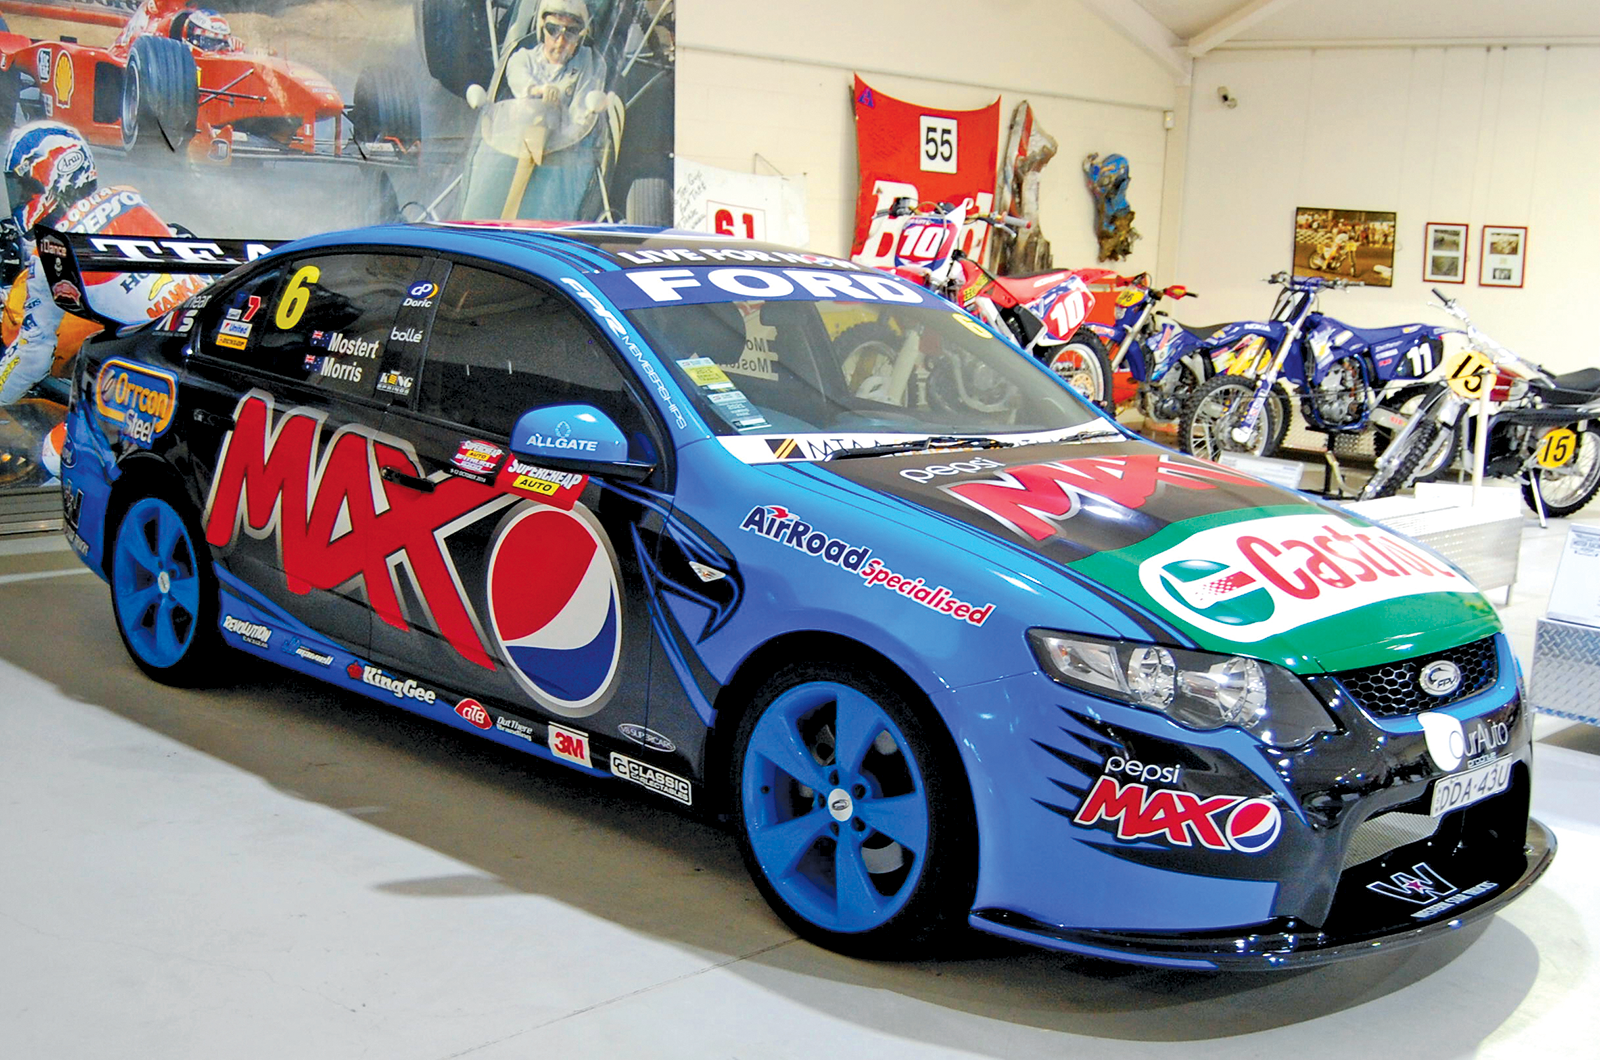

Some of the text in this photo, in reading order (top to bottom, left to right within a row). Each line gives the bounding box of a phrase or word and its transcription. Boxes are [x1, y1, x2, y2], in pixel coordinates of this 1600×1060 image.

[925, 127, 953, 162] 55
[62, 154, 81, 169] Arai
[617, 249, 707, 264] LIVE
[699, 249, 781, 263] FOR
[899, 225, 949, 258] 10
[276, 265, 320, 329] 6
[626, 268, 924, 304] FORD
[402, 298, 433, 308] Doric
[1050, 290, 1085, 338] 10
[328, 332, 380, 359] Mostert
[391, 327, 423, 343] bollé
[320, 356, 363, 382] Morris
[1406, 342, 1432, 377] 11
[1451, 355, 1485, 393] 15
[115, 372, 170, 420] Orrcon
[621, 335, 687, 429] MEMBERSHIPS
[125, 409, 157, 446] Steel
[526, 434, 598, 452] ALLGATE
[1542, 436, 1571, 462] 15
[508, 459, 583, 490] SUPERCHEAP
[520, 478, 553, 492] AUTO
[900, 457, 1007, 484] pepsi
[202, 390, 516, 672] MAX
[739, 505, 872, 574] AirRoad
[1235, 525, 1457, 600] Castrol
[860, 558, 997, 628] Specialised
[223, 615, 273, 642] REVOLUTION
[363, 665, 436, 704] KingGee
[1436, 675, 1457, 689] FPV
[463, 705, 486, 724] OTB
[554, 731, 585, 760] 3M
[629, 762, 688, 795] CLASSIC
[1105, 756, 1181, 784] pepsi
[1074, 775, 1249, 851] MAX
